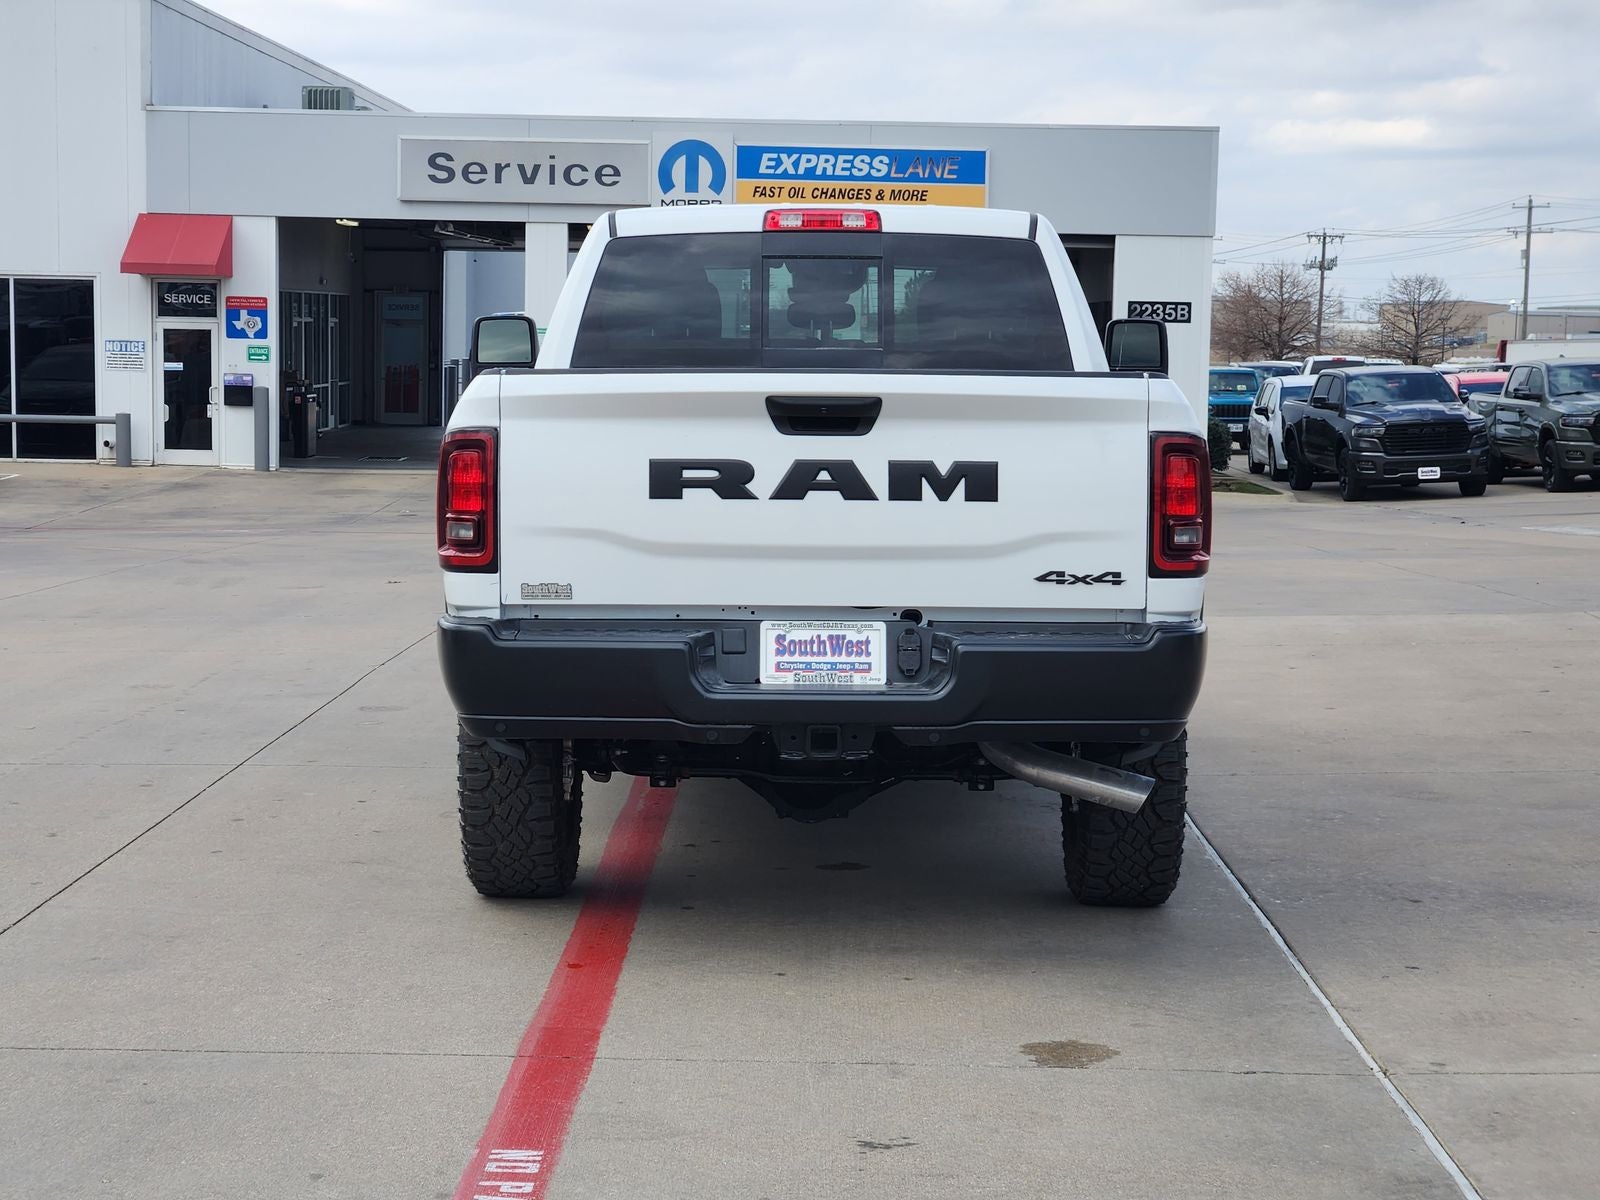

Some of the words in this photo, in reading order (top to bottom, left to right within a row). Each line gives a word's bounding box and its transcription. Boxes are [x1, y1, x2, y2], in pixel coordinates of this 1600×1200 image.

[427, 152, 622, 187] Service
[752, 186, 784, 199] FAST
[788, 187, 807, 200] OIL
[811, 188, 872, 201] CHANGES
[875, 189, 886, 201] &
[889, 190, 928, 202] MORE
[164, 293, 212, 304] SERVICE
[1130, 303, 1189, 321] 2235B
[105, 341, 145, 352] NOTICE
[648, 458, 999, 503] RAM
[1033, 571, 1128, 586] 4x4
[521, 583, 572, 594] SouthWest
[774, 633, 871, 657] SouthWest
[779, 662, 806, 671] Chrysler
[811, 663, 832, 671] Dodge
[836, 662, 852, 671] Jeep
[793, 673, 854, 683] SouthWest
